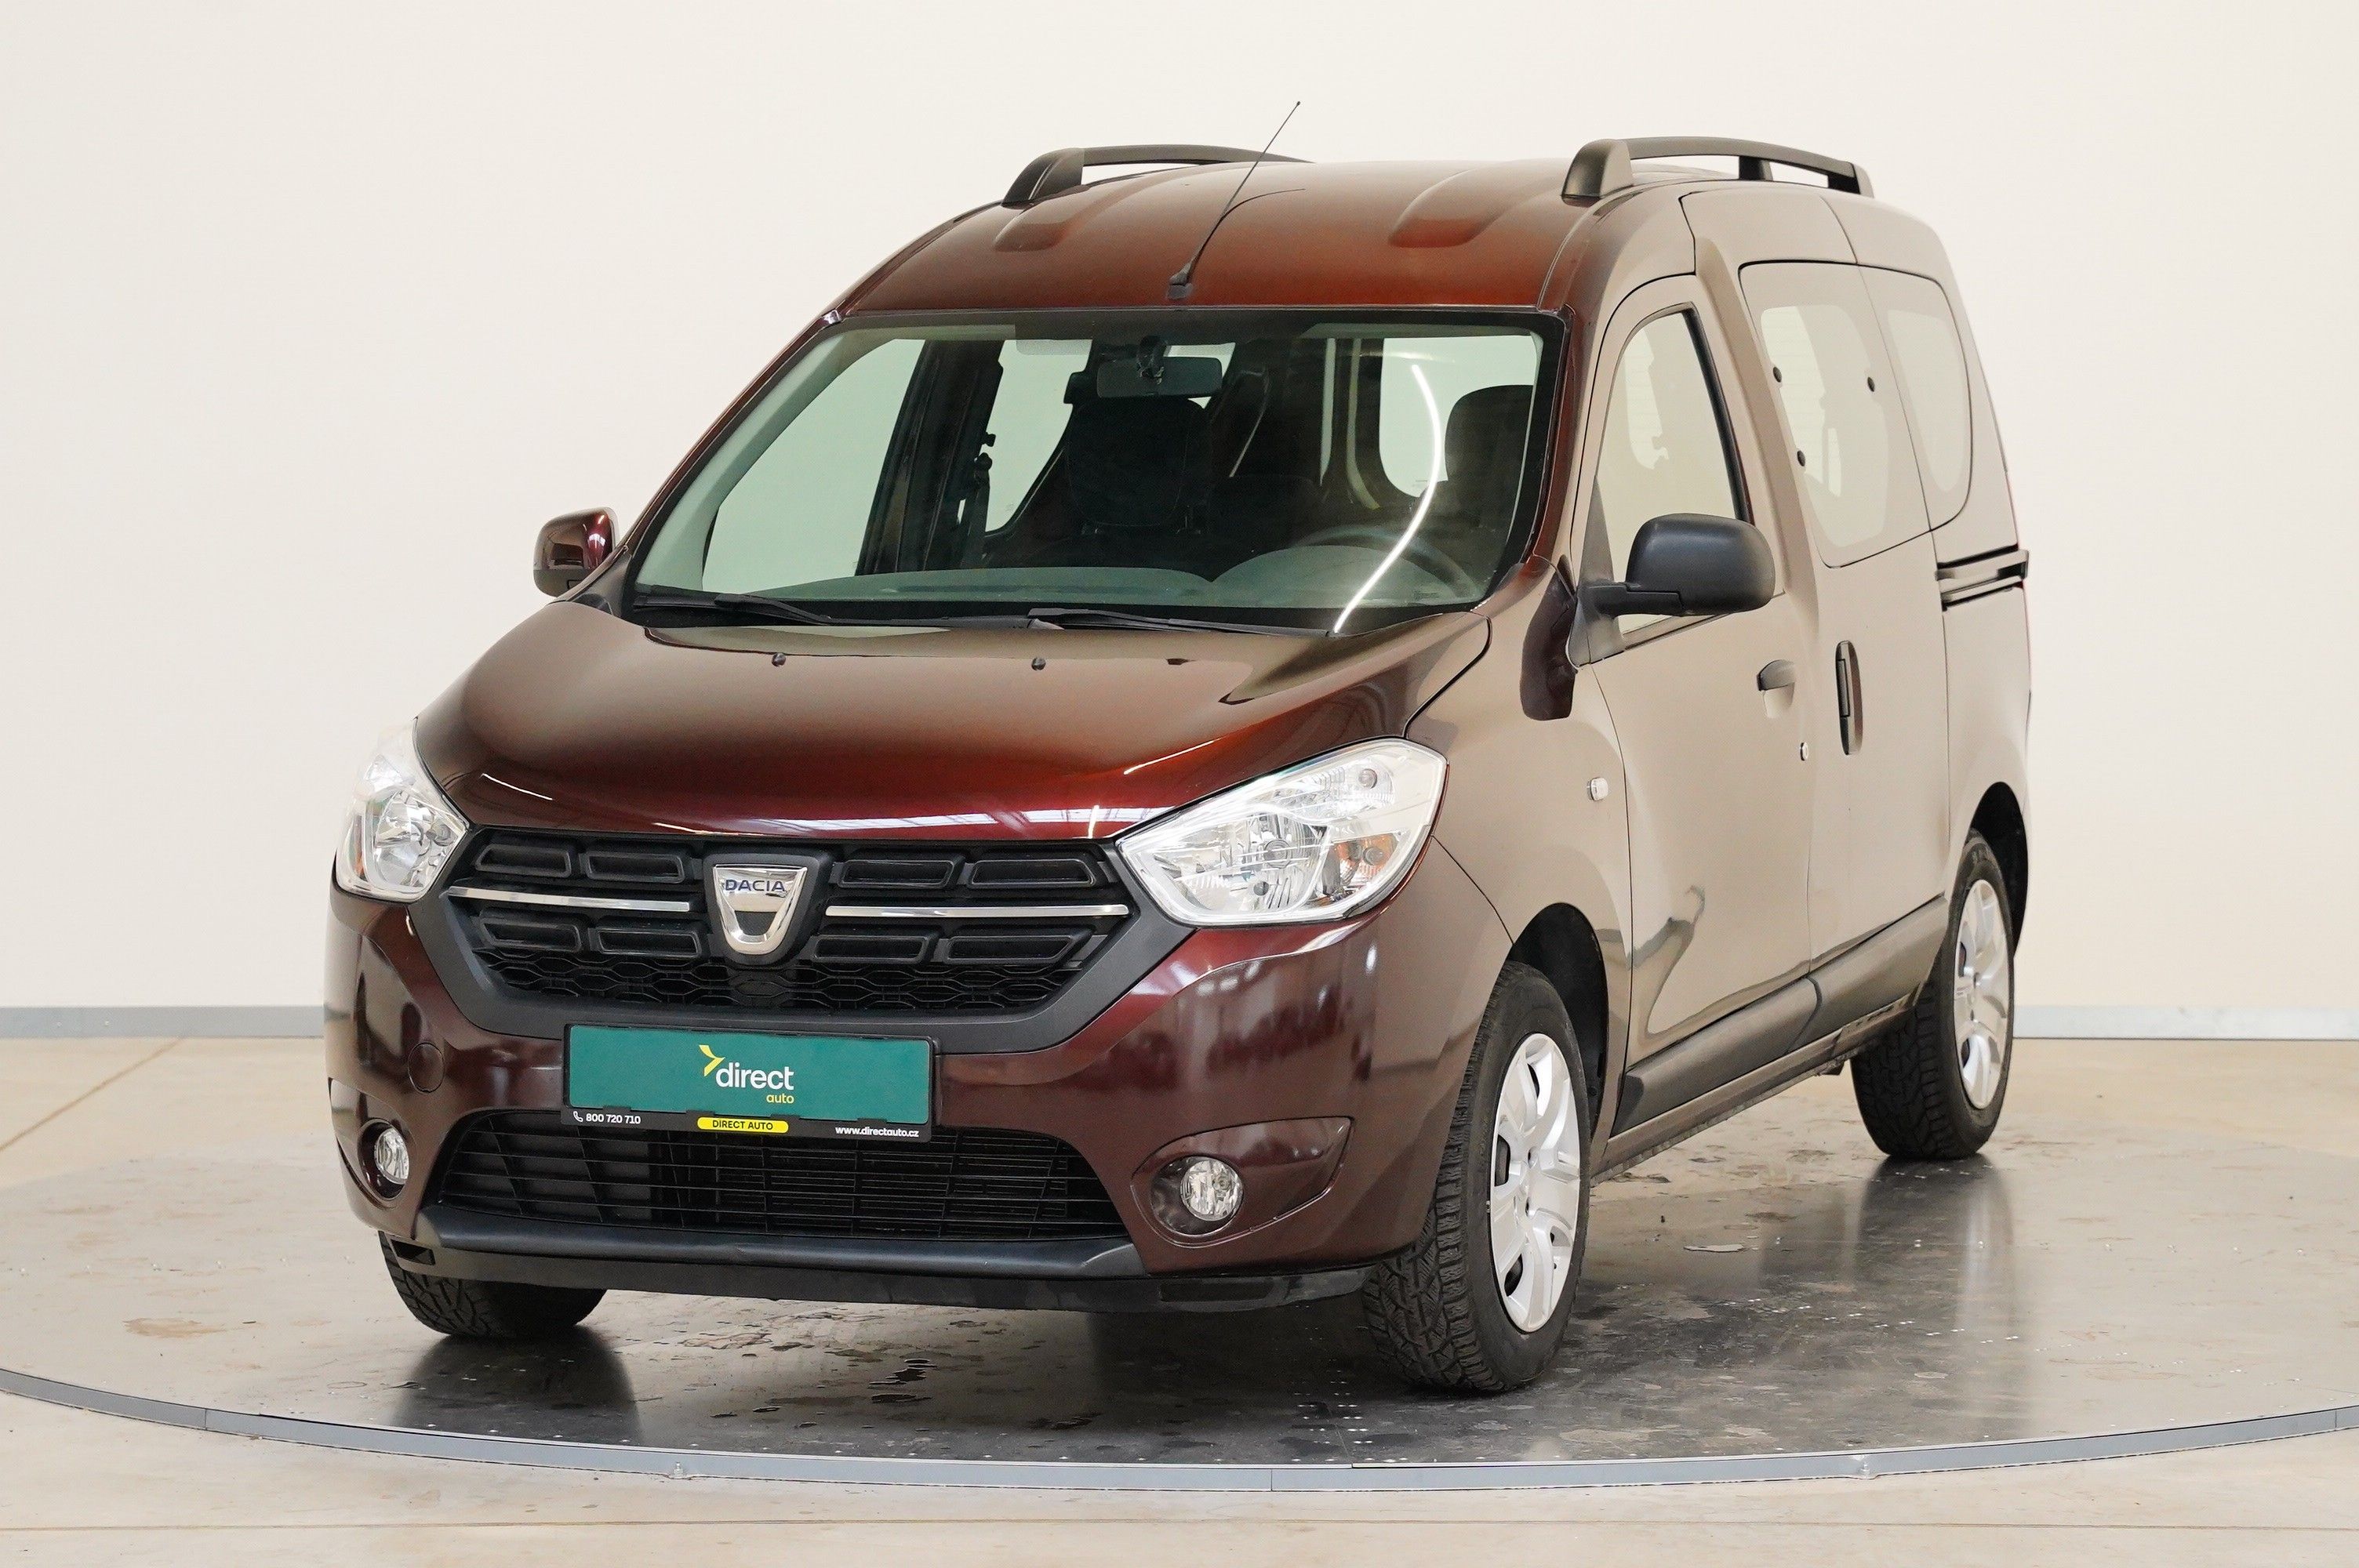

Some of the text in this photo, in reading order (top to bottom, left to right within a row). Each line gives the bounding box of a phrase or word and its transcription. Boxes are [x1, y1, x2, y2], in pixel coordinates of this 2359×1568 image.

[725, 879, 785, 891] DACIA
[715, 1062, 794, 1091] direct
[766, 1093, 794, 1104] auto
[586, 1112, 642, 1124] 800 720 710
[712, 1120, 773, 1131] DIRECT AUTO
[834, 1126, 919, 1138] www.directauto.cz
